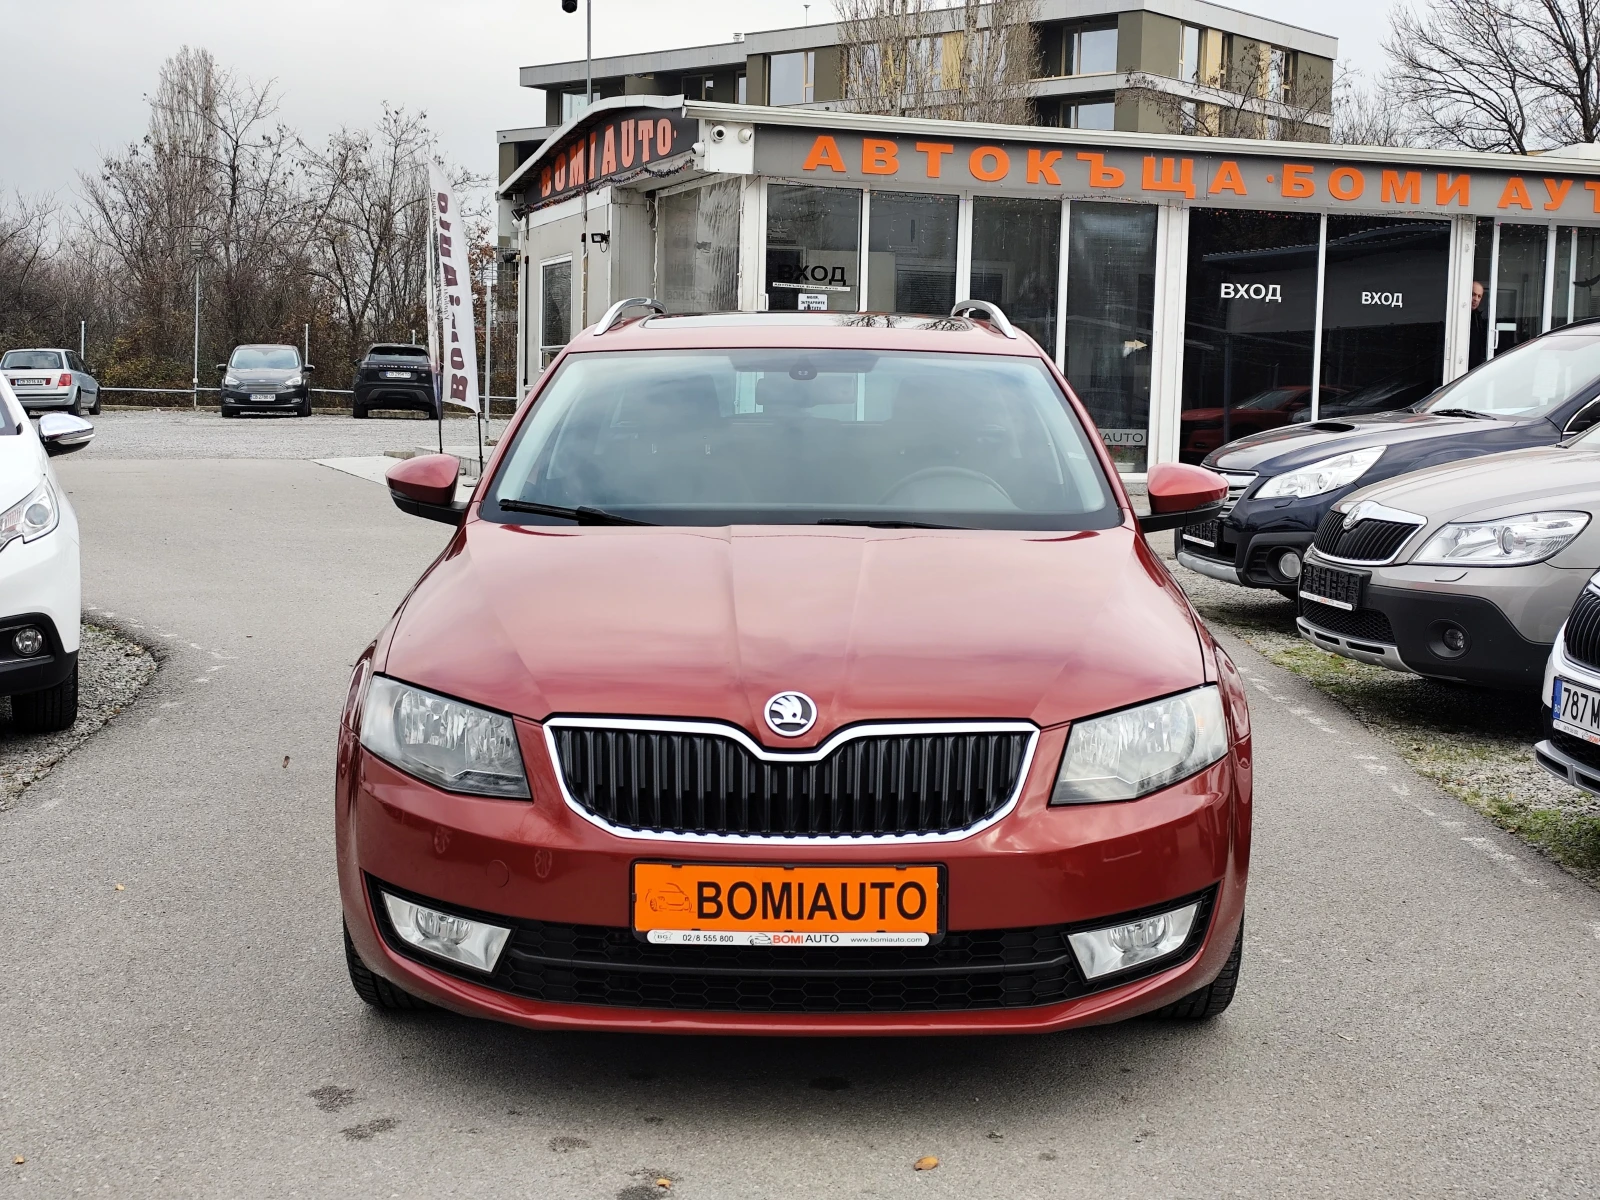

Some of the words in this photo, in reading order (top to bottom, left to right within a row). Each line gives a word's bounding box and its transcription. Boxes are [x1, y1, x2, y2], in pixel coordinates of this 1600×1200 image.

[541, 118, 672, 198] BOMIAUTO
[803, 135, 1248, 199] АВТОКЪЩА
[1281, 163, 1471, 207] БОМИ
[777, 264, 847, 286] ВХОД
[1220, 283, 1282, 302] ВХОД
[1361, 291, 1403, 308] ВХОД
[1562, 687, 1589, 723] 787
[696, 880, 928, 921] BOMIAUTO
[682, 934, 701, 942] 02/8
[703, 934, 718, 942] 555
[719, 935, 734, 943] 800
